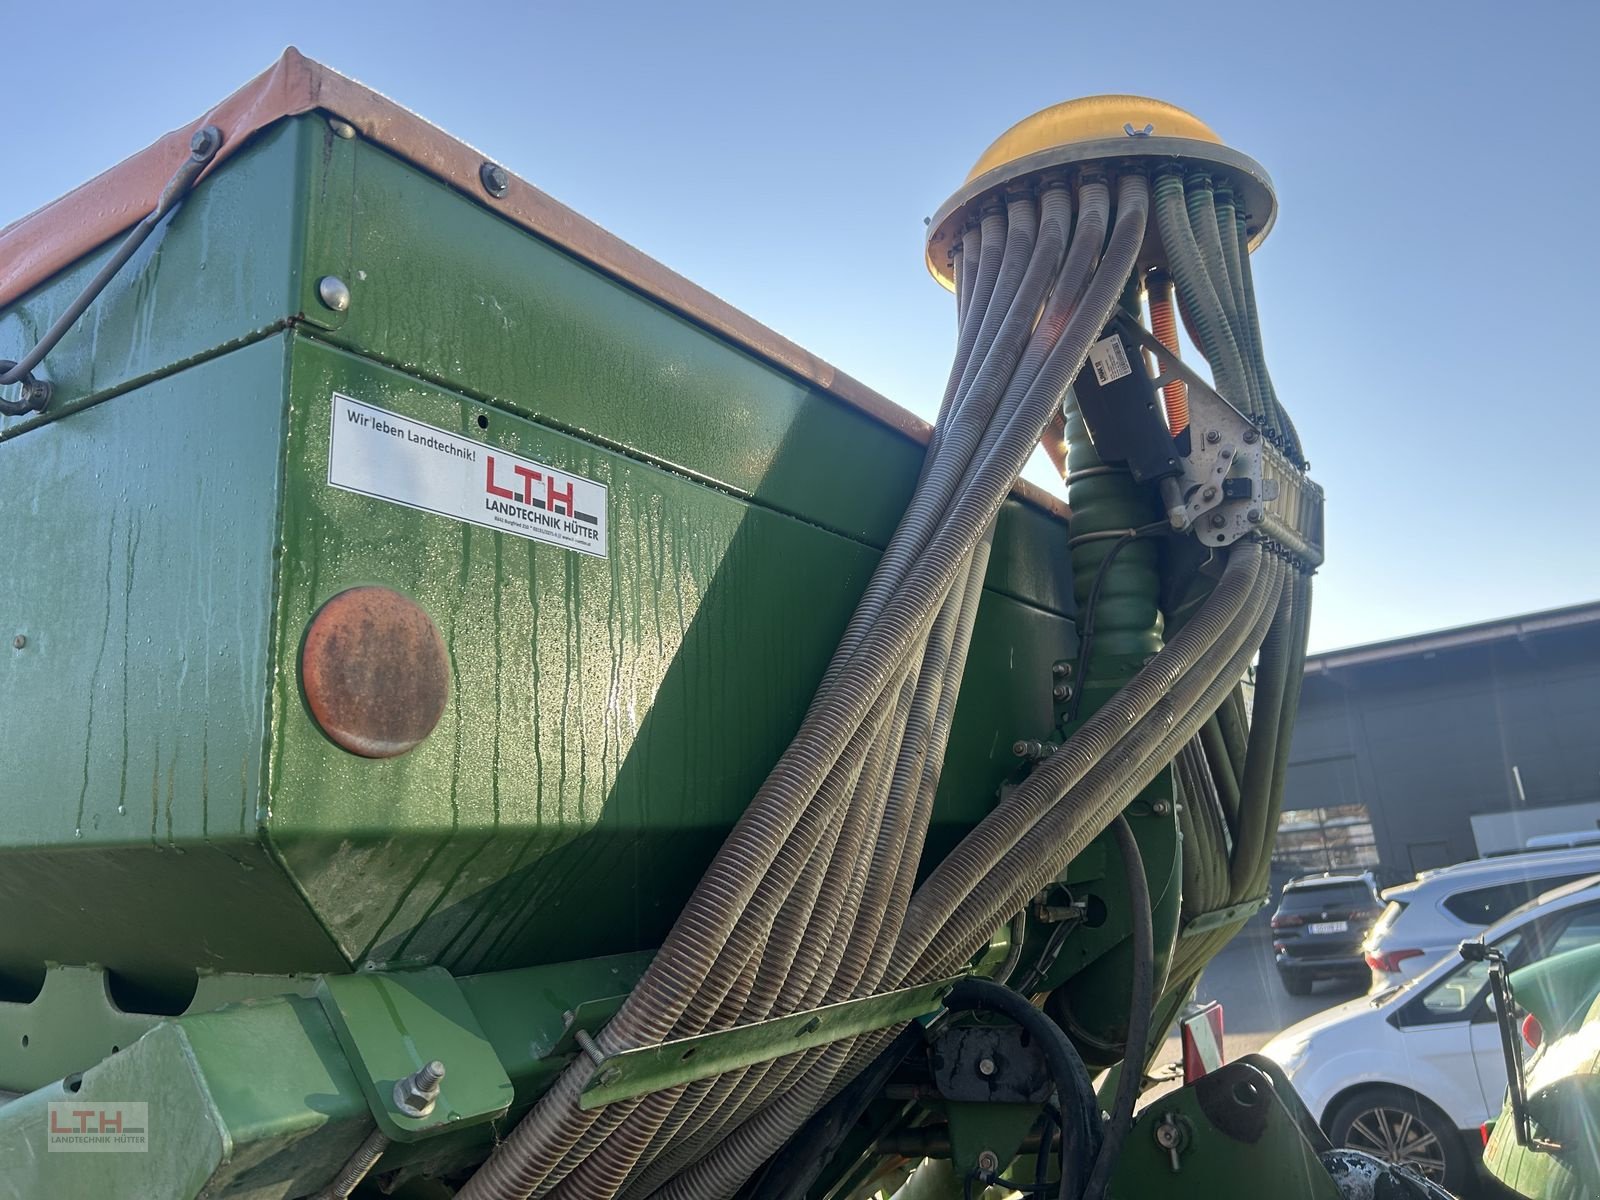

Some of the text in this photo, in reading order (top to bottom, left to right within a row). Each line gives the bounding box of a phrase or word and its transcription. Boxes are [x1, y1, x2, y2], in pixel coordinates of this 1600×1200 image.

[347, 409, 476, 462] Wir leben Landtechnik!
[486, 498, 561, 530] LANDTECHNIK
[564, 520, 599, 540] HÜTTER
